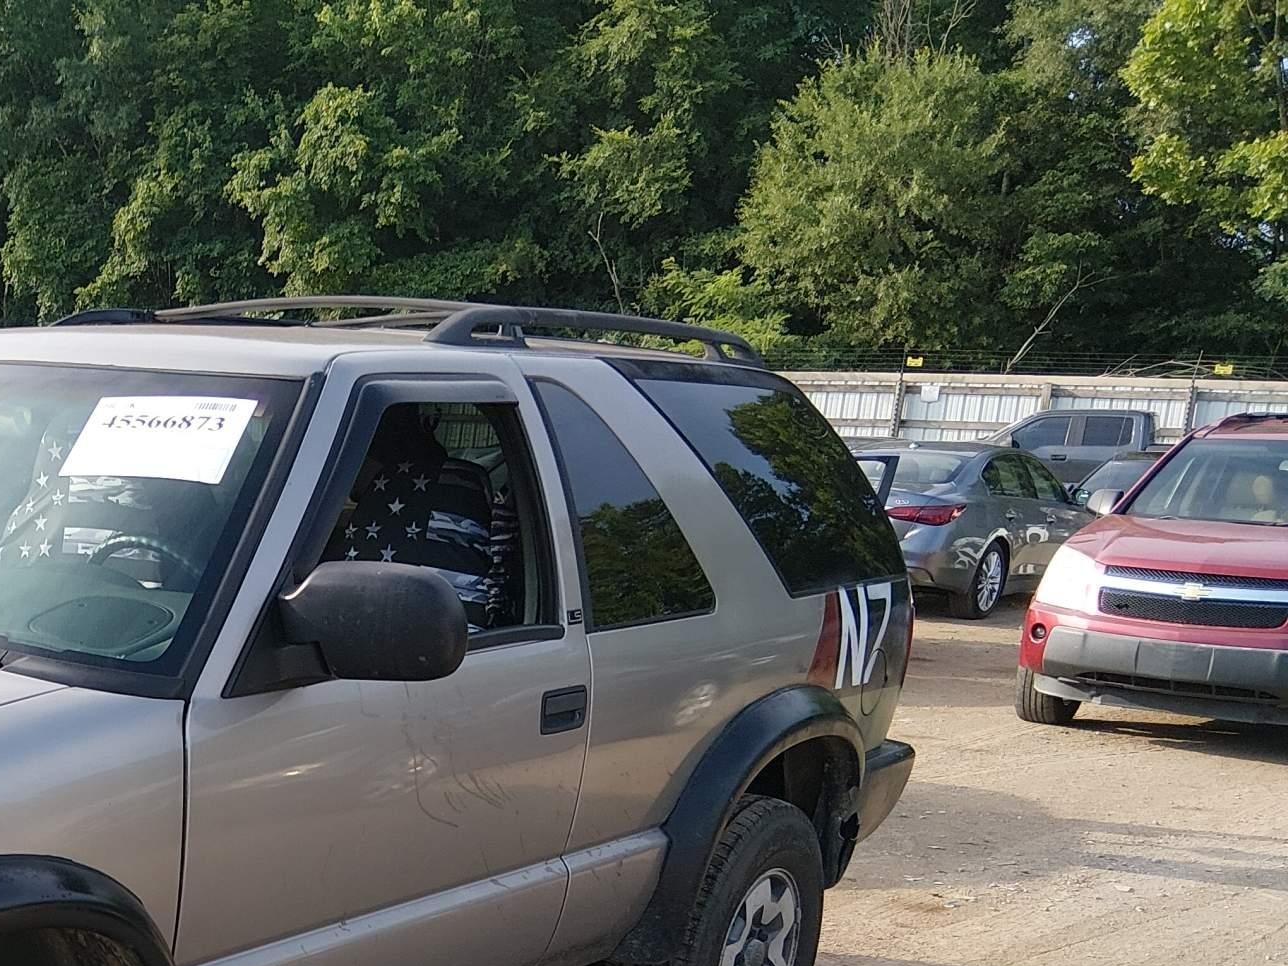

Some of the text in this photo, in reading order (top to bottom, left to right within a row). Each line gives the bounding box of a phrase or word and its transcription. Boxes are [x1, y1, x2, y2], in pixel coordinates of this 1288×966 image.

[102, 415, 225, 432] 45566873
[567, 610, 582, 623] LS
[834, 582, 892, 690] N7
